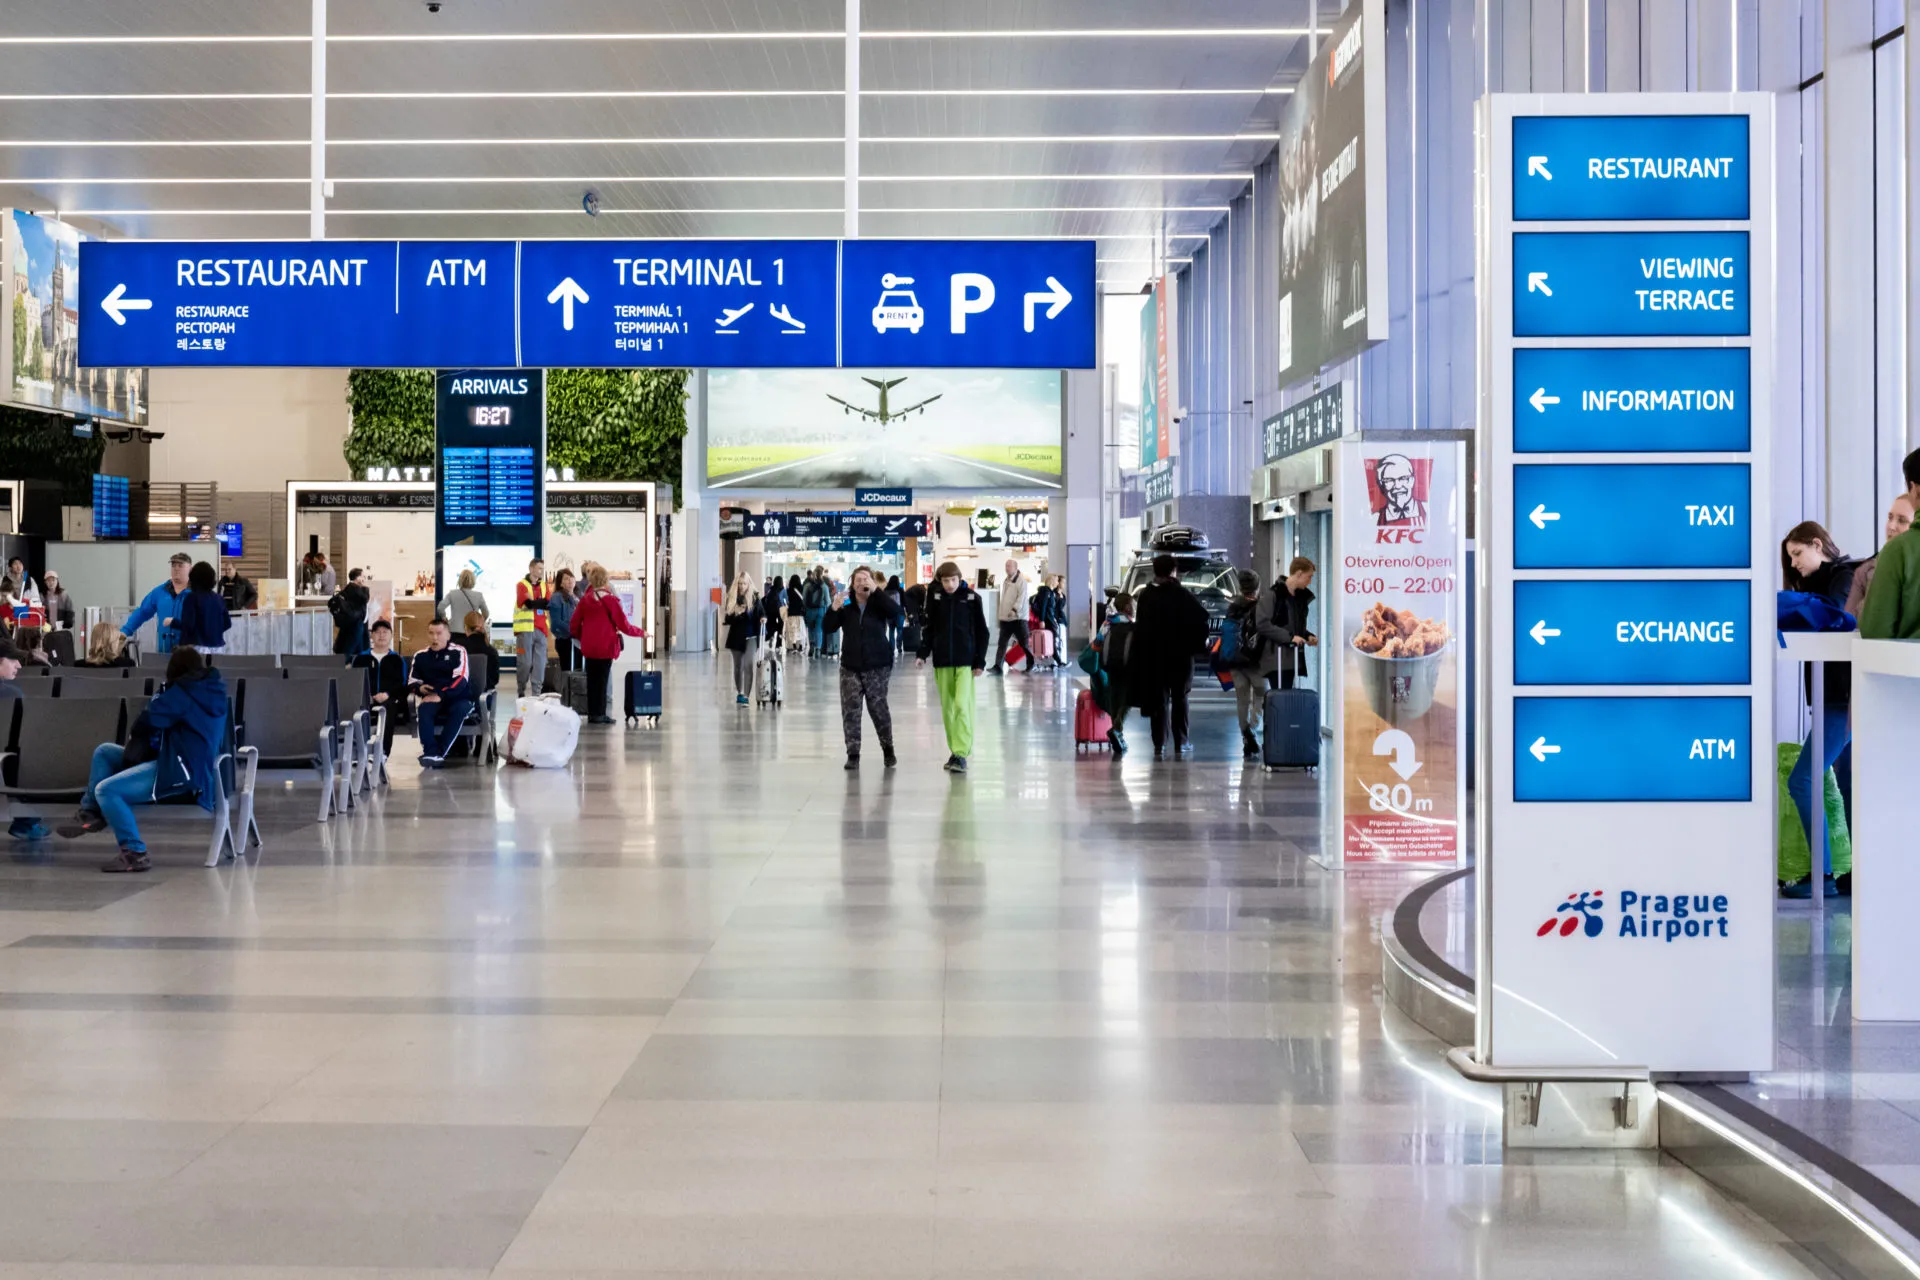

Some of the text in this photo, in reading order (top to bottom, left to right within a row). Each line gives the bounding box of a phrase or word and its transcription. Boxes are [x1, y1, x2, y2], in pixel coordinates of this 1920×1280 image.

[1588, 157, 1734, 179] RESTAURANT
[176, 259, 368, 286] RESTAURANT
[425, 259, 487, 286] ATM
[613, 258, 784, 286] TERMINAL 1
[1640, 257, 1734, 279] VIEWING
[950, 273, 996, 334] P
[1635, 289, 1735, 311] TERRACE
[175, 306, 249, 318] RESTAURACE
[614, 303, 683, 318] TERMINÁL 1
[886, 311, 911, 321] RENT
[175, 322, 236, 334] РЕСТОРАН
[614, 321, 689, 335] ТЕРМИНАЛ 1
[176, 338, 227, 351] 레스토랑
[615, 338, 664, 352] 터미널 1
[450, 378, 529, 395] ARRIVALS
[1581, 390, 1736, 411] INFORMATION
[475, 406, 511, 426] 16:27
[546, 494, 567, 504] OJITO
[860, 492, 907, 503] JCDecaux
[795, 516, 823, 524] TERMINAL
[842, 516, 877, 524] DEPARTURES
[1009, 513, 1049, 534] UGO
[1685, 505, 1734, 526] TAXI
[1375, 528, 1425, 544] KFC
[1345, 555, 1452, 570] Otevřeno/Open
[1345, 577, 1385, 594] 6:00
[1404, 577, 1453, 594] 22:00
[1616, 621, 1734, 642] EXCHANGE
[1689, 738, 1736, 760] ATM
[1369, 783, 1433, 812] 80 m
[1620, 891, 1729, 918] Prague
[1619, 915, 1729, 942] Airport
